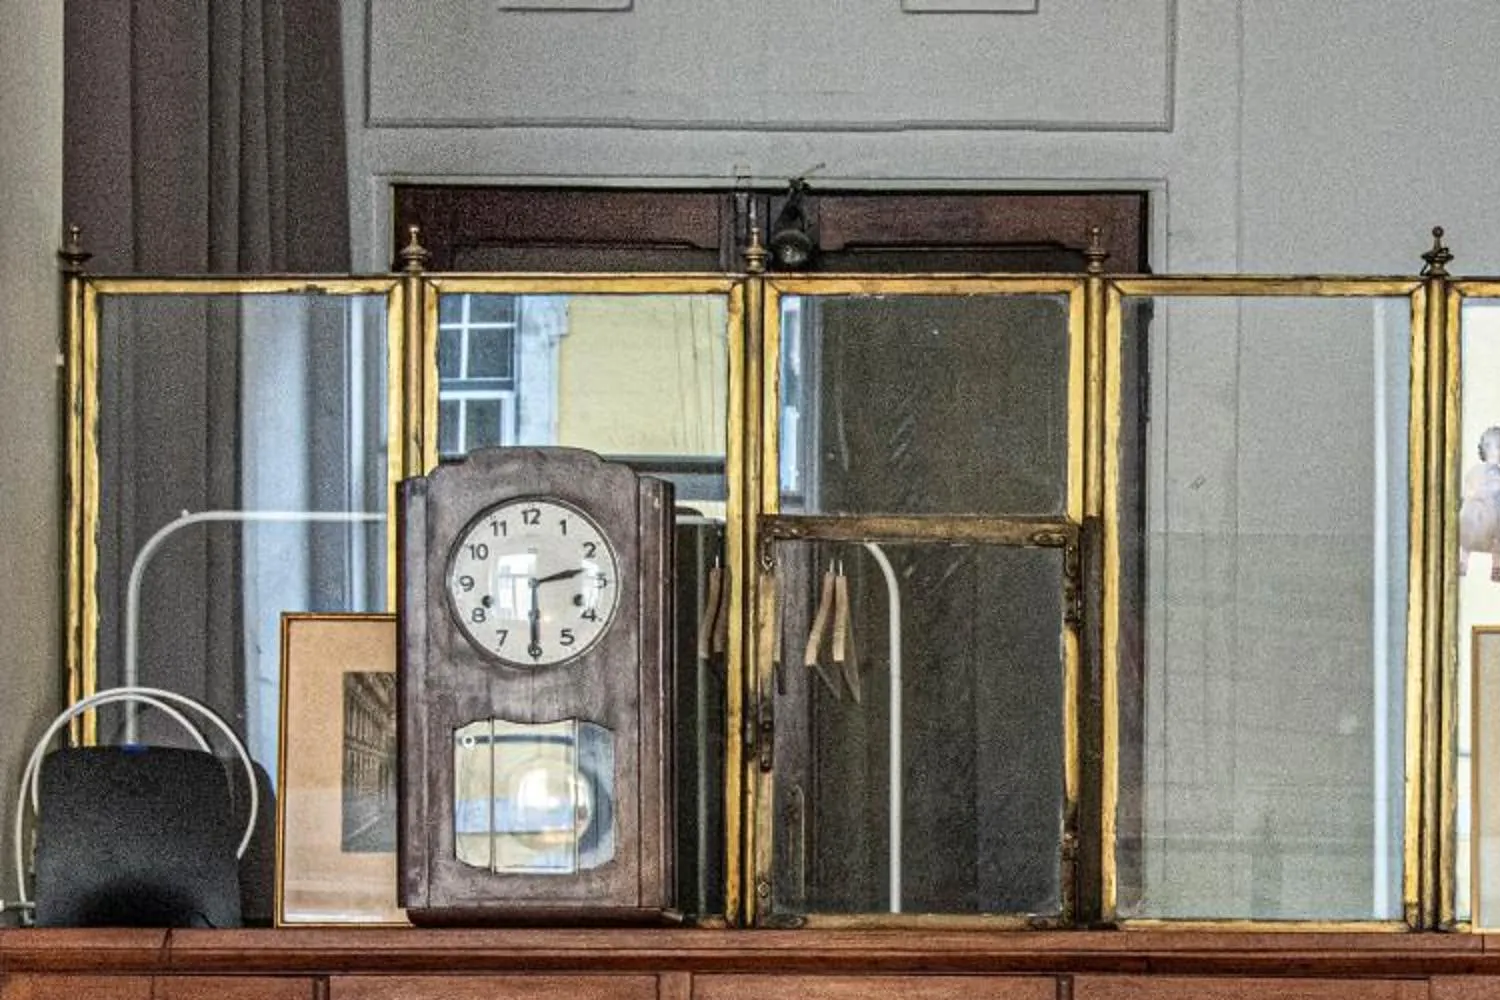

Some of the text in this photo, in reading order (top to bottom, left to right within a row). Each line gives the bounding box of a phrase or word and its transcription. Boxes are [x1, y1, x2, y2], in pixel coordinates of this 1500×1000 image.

[521, 509, 541, 525] 12
[491, 521, 507, 536] 11
[560, 520, 568, 536] 1
[469, 544, 489, 560] 10
[583, 542, 597, 558] 2
[459, 576, 475, 591] 9
[472, 608, 486, 623] 8
[581, 608, 597, 622] 4
[496, 630, 509, 646] 7
[560, 628, 575, 646] 5
